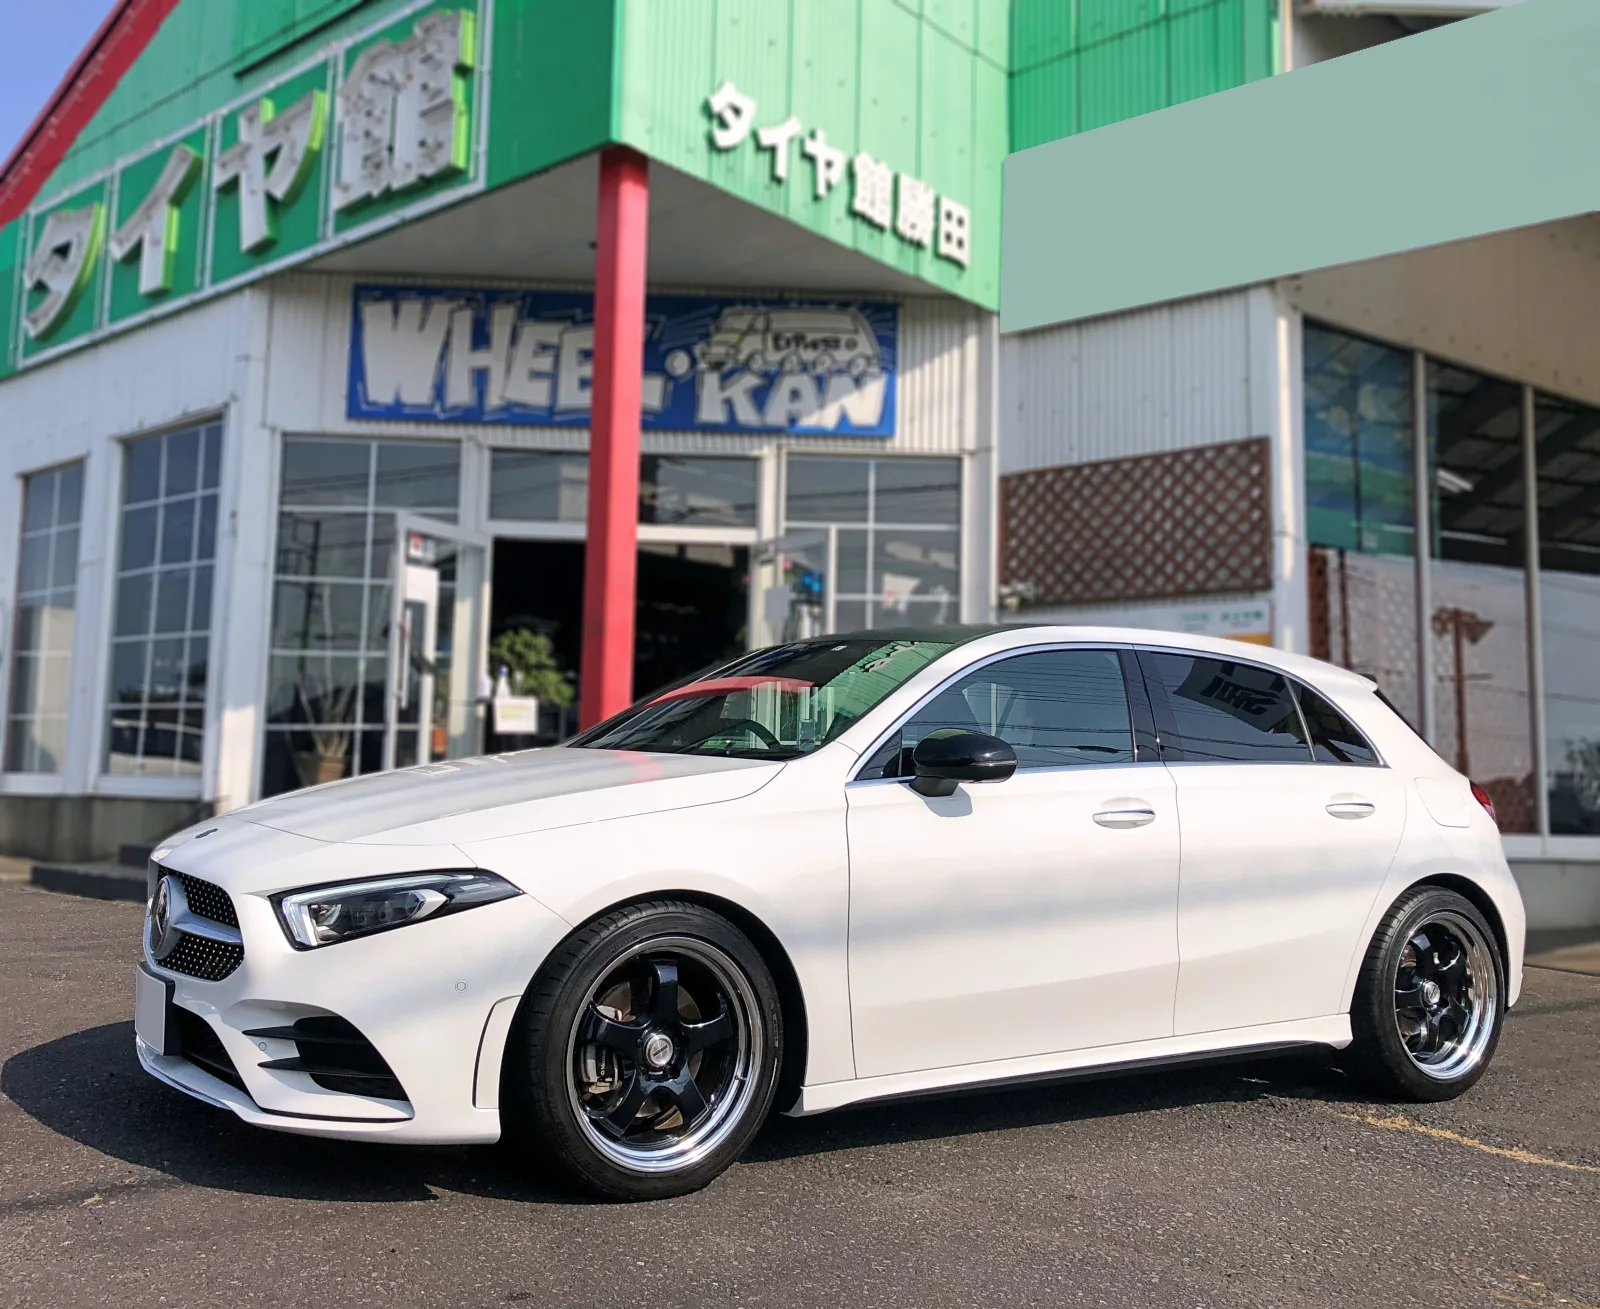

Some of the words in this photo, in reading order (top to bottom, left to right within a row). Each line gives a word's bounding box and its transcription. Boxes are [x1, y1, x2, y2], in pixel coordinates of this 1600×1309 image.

[24, 8, 476, 341] タイヤ館
[697, 371, 887, 431] KAN
